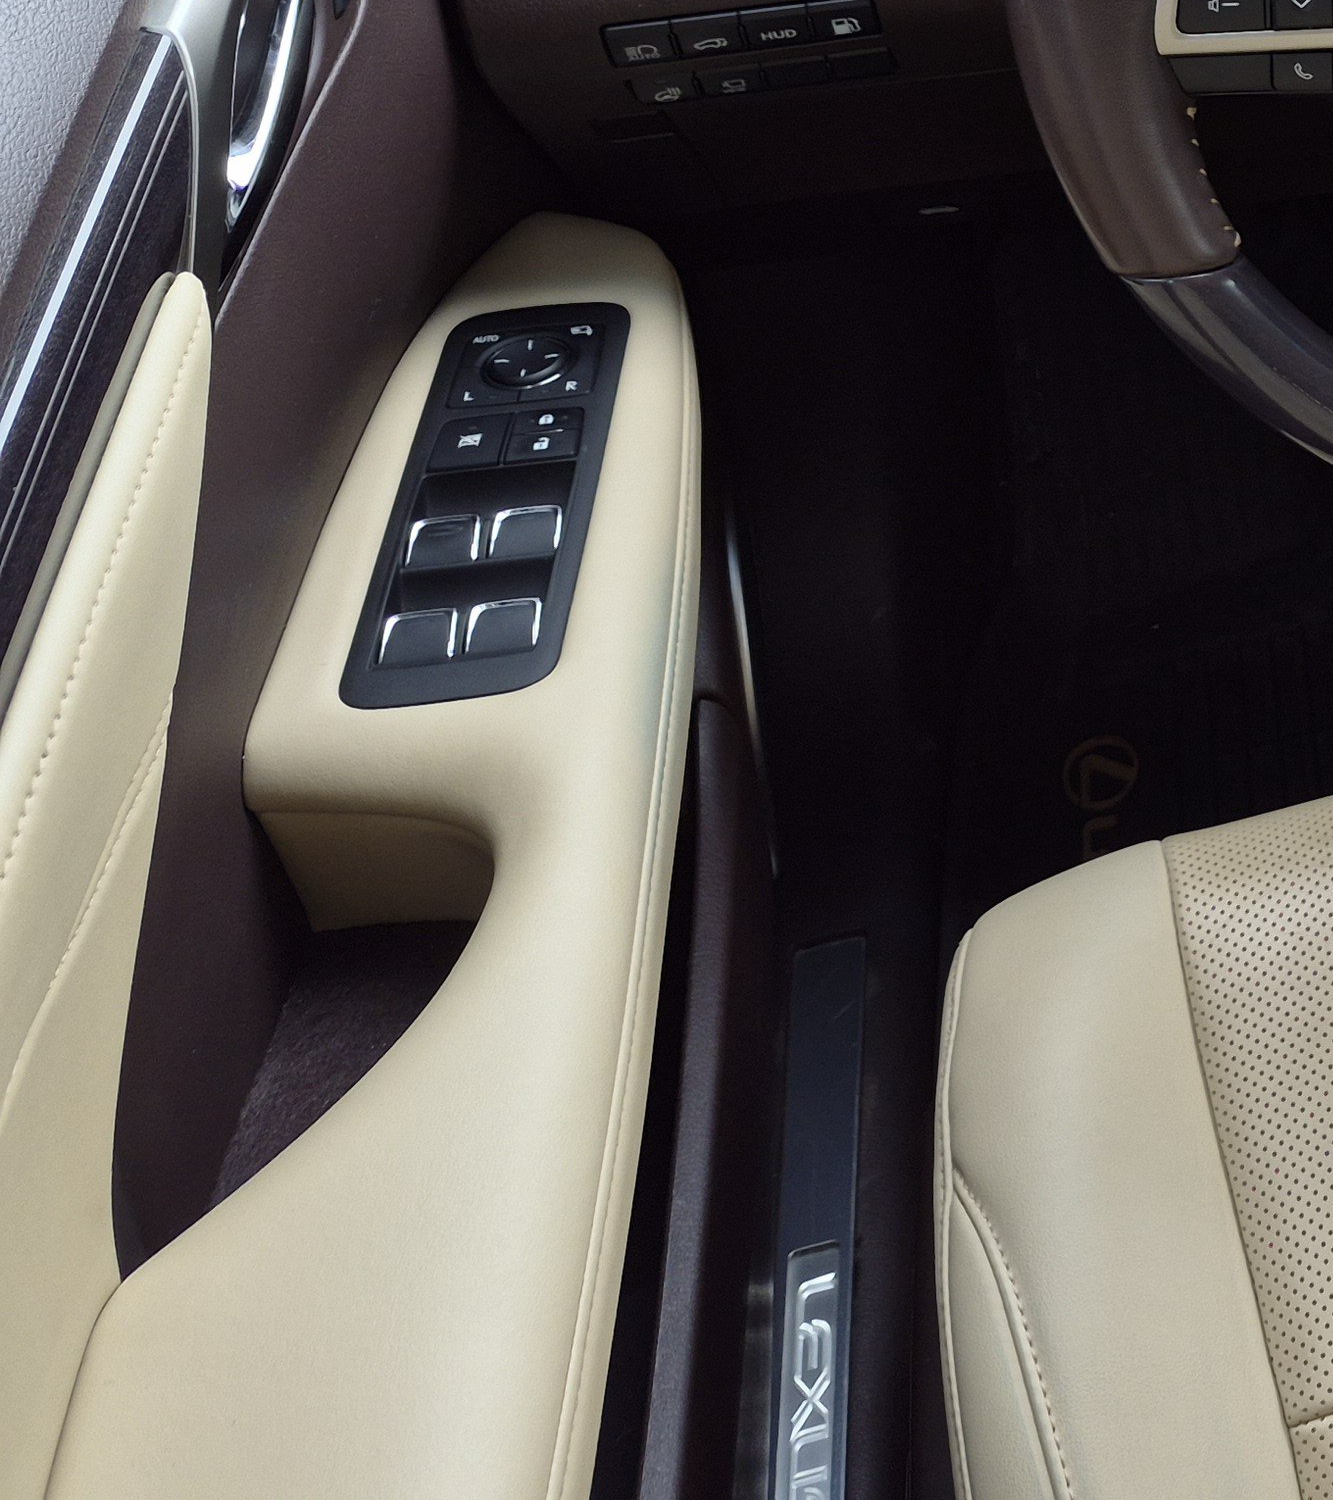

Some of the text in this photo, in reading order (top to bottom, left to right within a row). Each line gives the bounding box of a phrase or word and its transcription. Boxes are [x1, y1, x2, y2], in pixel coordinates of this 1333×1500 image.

[760, 28, 797, 41] HUD
[472, 334, 500, 344] AUTO
[565, 380, 578, 391] R
[463, 391, 474, 401] L
